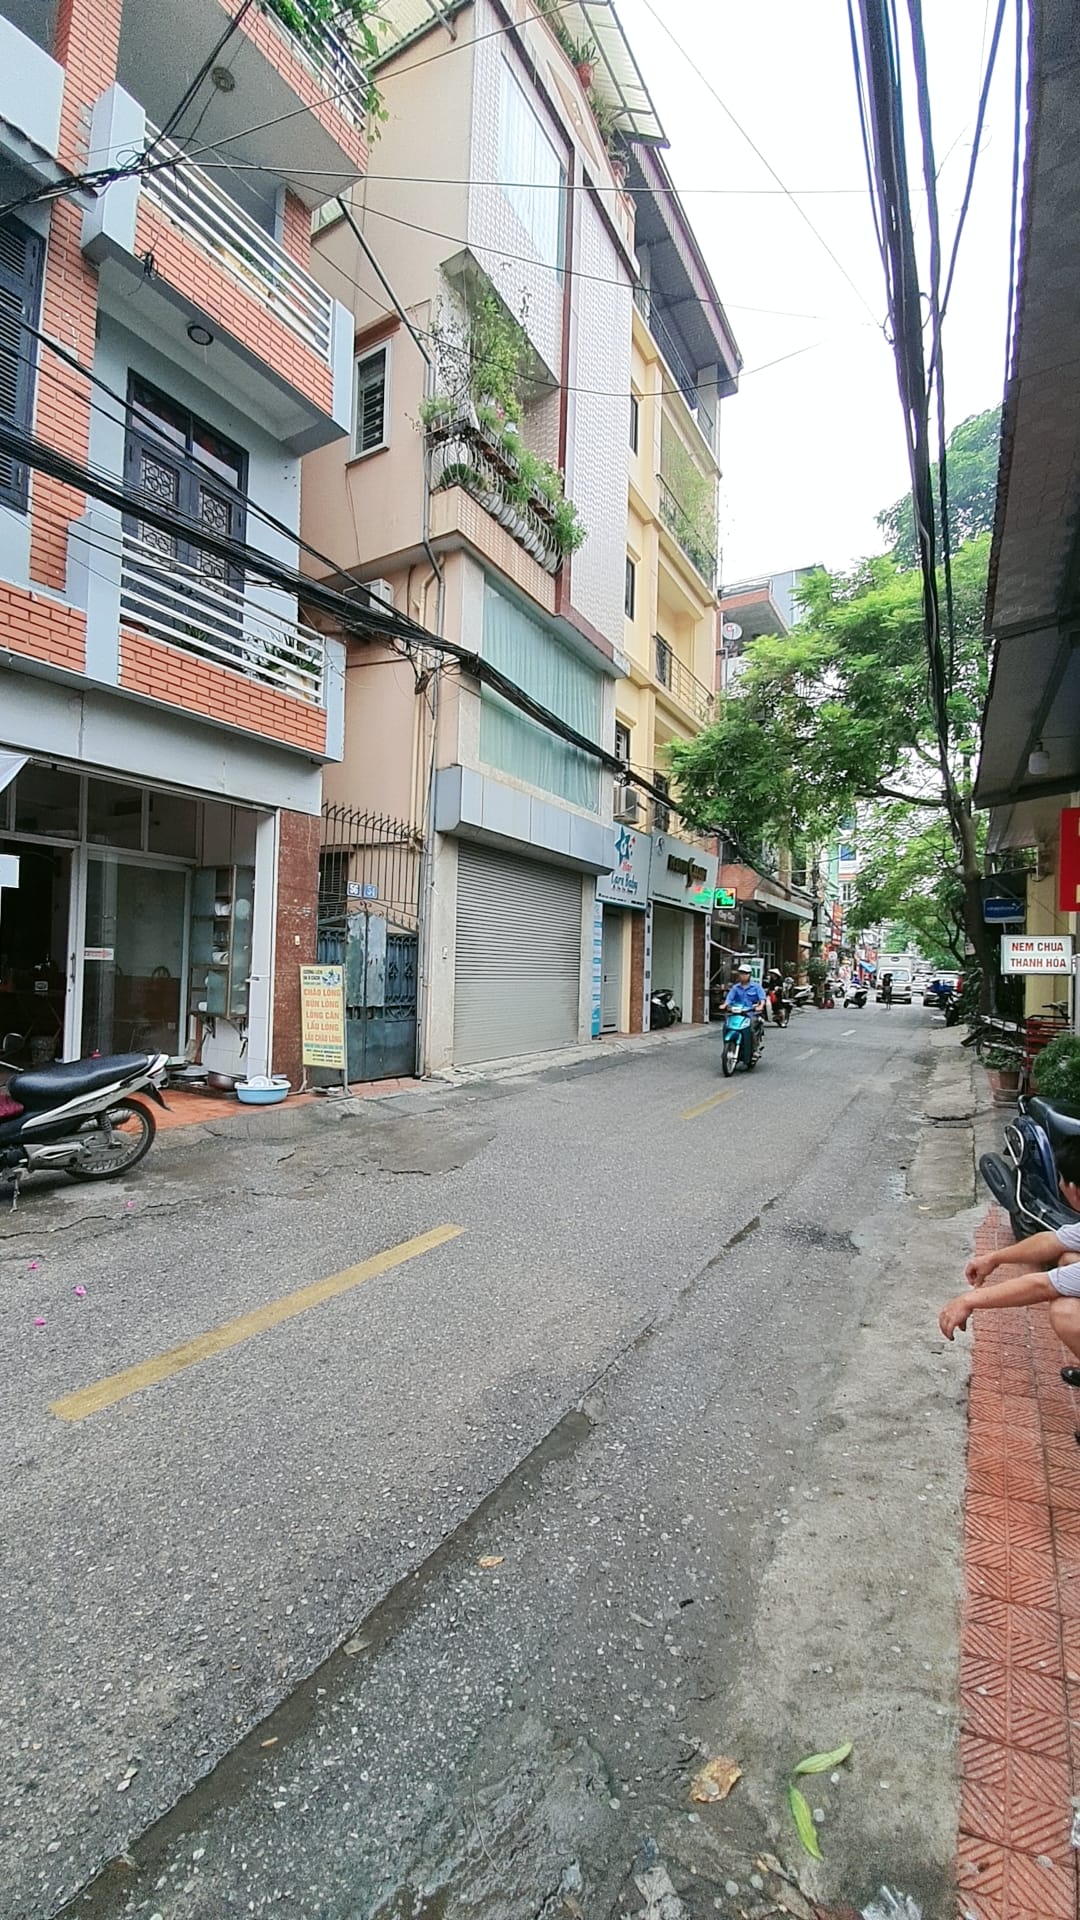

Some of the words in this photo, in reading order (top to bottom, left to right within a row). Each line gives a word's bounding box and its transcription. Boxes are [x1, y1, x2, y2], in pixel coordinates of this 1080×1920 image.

[1011, 942, 1034, 952] NEM
[1037, 942, 1064, 952] CHUA
[1010, 958, 1043, 968] THANH
